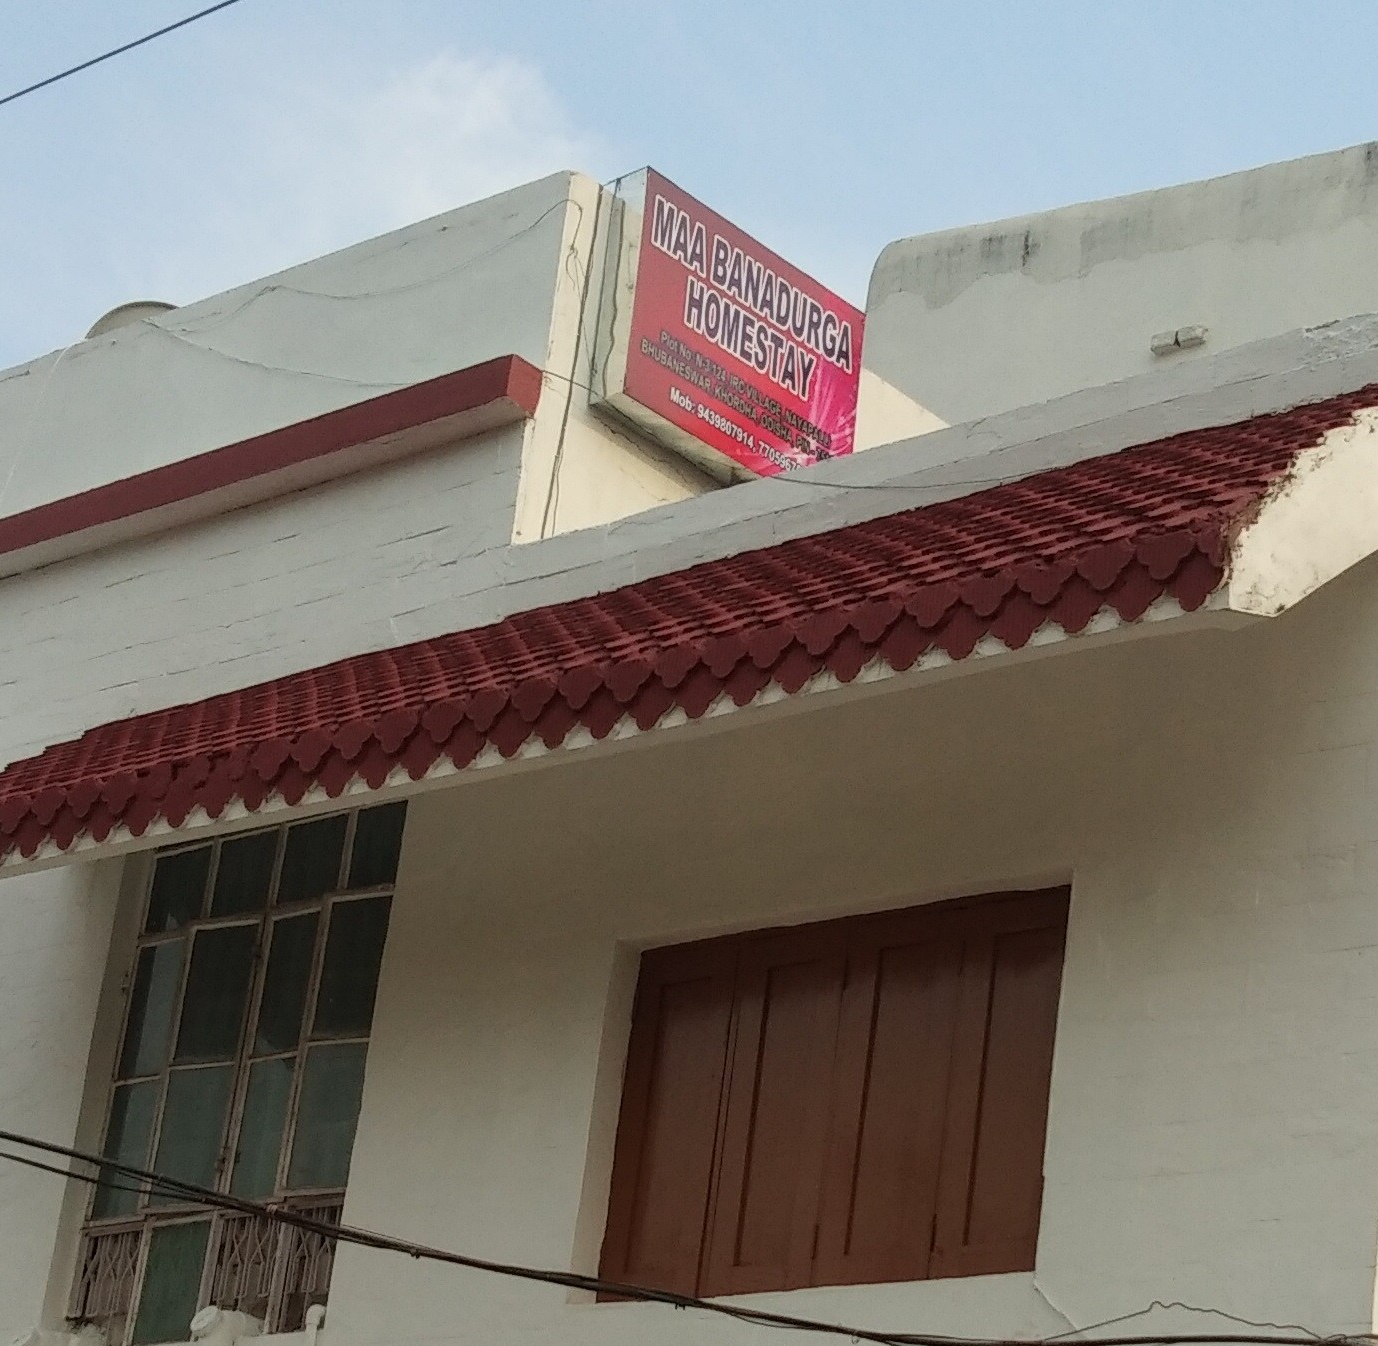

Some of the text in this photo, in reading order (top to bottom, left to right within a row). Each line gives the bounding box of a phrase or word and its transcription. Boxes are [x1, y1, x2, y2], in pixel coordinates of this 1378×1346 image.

[651, 194, 853, 375] MAA BANADURGA
[683, 275, 817, 402] HOMESTAY
